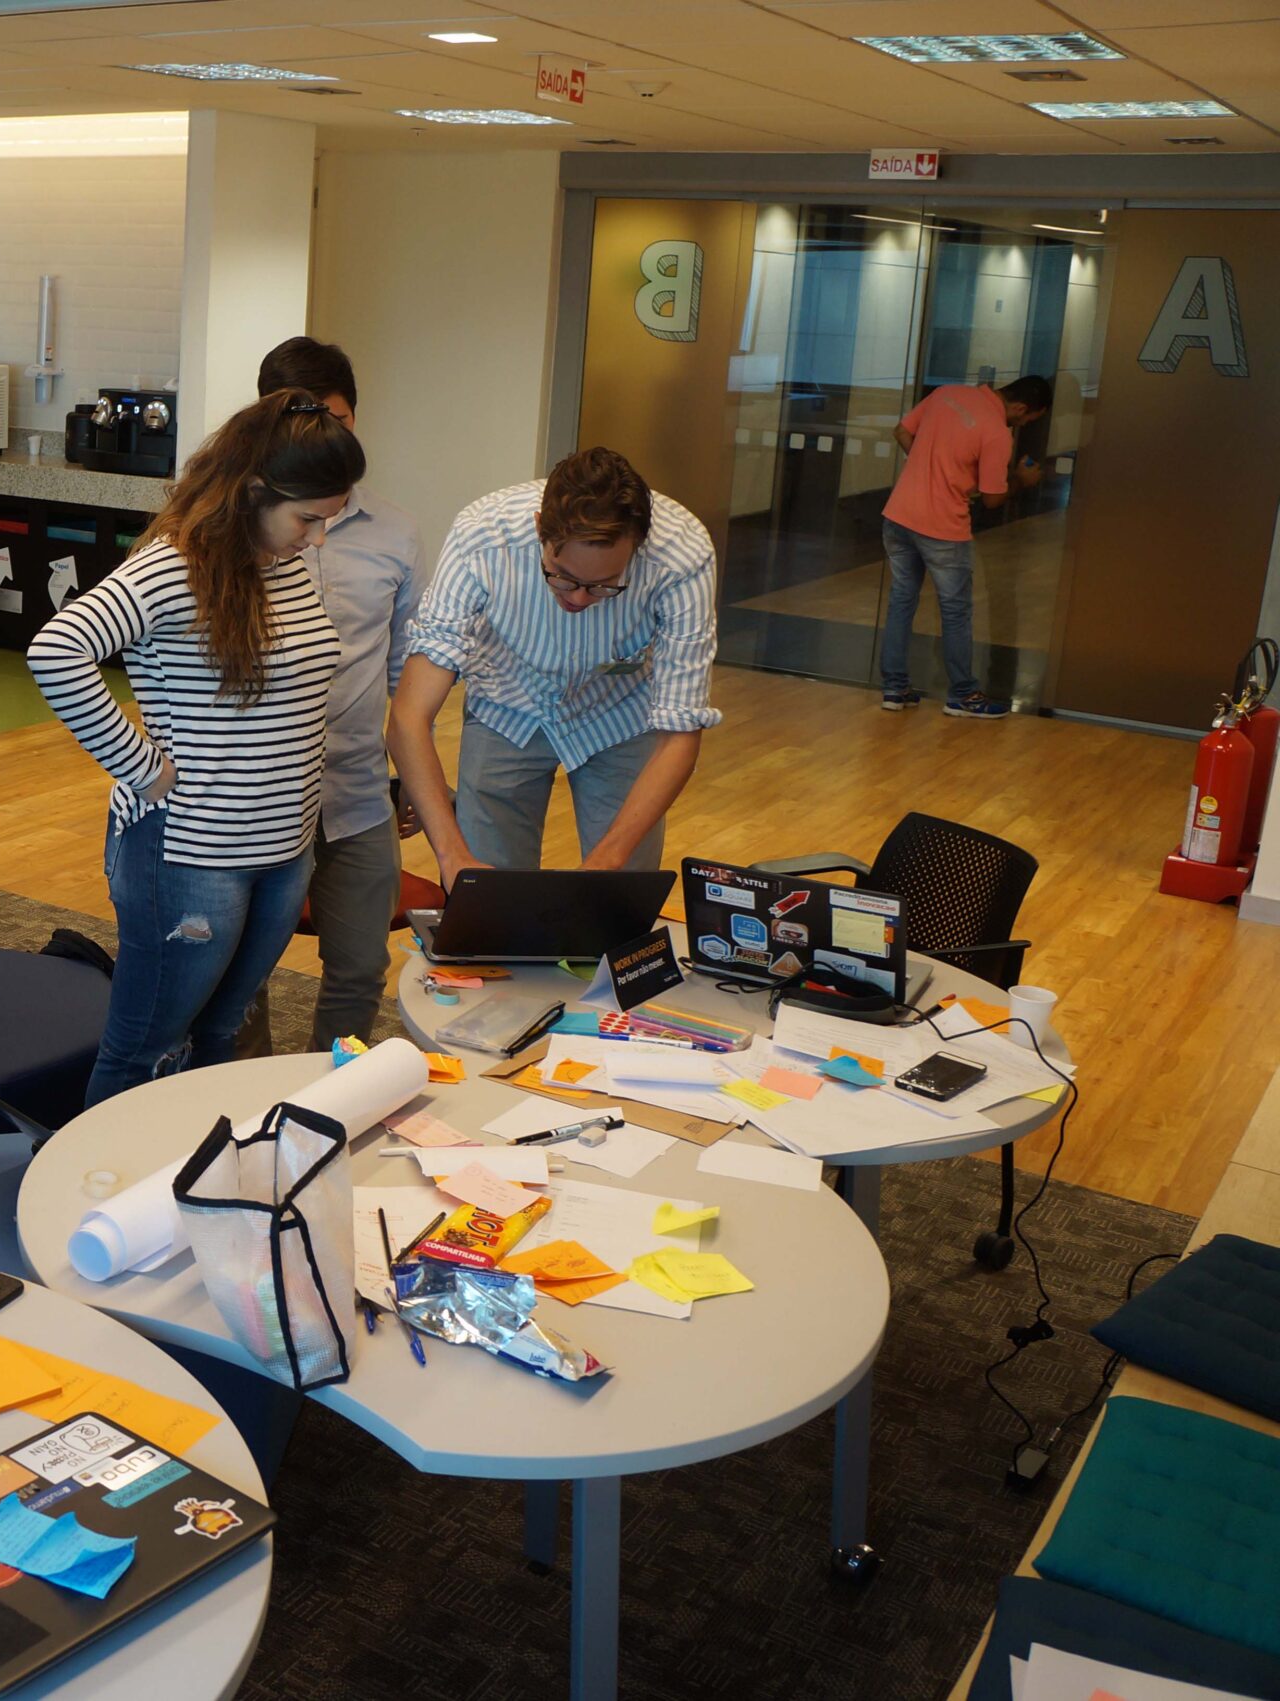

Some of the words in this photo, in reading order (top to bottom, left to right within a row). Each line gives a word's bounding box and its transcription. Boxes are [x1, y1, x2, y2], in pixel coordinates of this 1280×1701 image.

[540, 71, 569, 95] SAÍDA
[871, 156, 913, 174] SAÍDA
[1138, 256, 1249, 377] A
[55, 562, 69, 570] Papel
[613, 956, 632, 972] WORK
[637, 939, 667, 961] PROGRESS
[617, 974, 627, 986] Por
[626, 969, 640, 983] favor
[425, 1241, 486, 1263] COMPARTILHAR
[29, 1439, 58, 1457] GAIN
[48, 1442, 66, 1457] NO
[67, 1455, 86, 1469] NO
[101, 1449, 156, 1482] cubo
